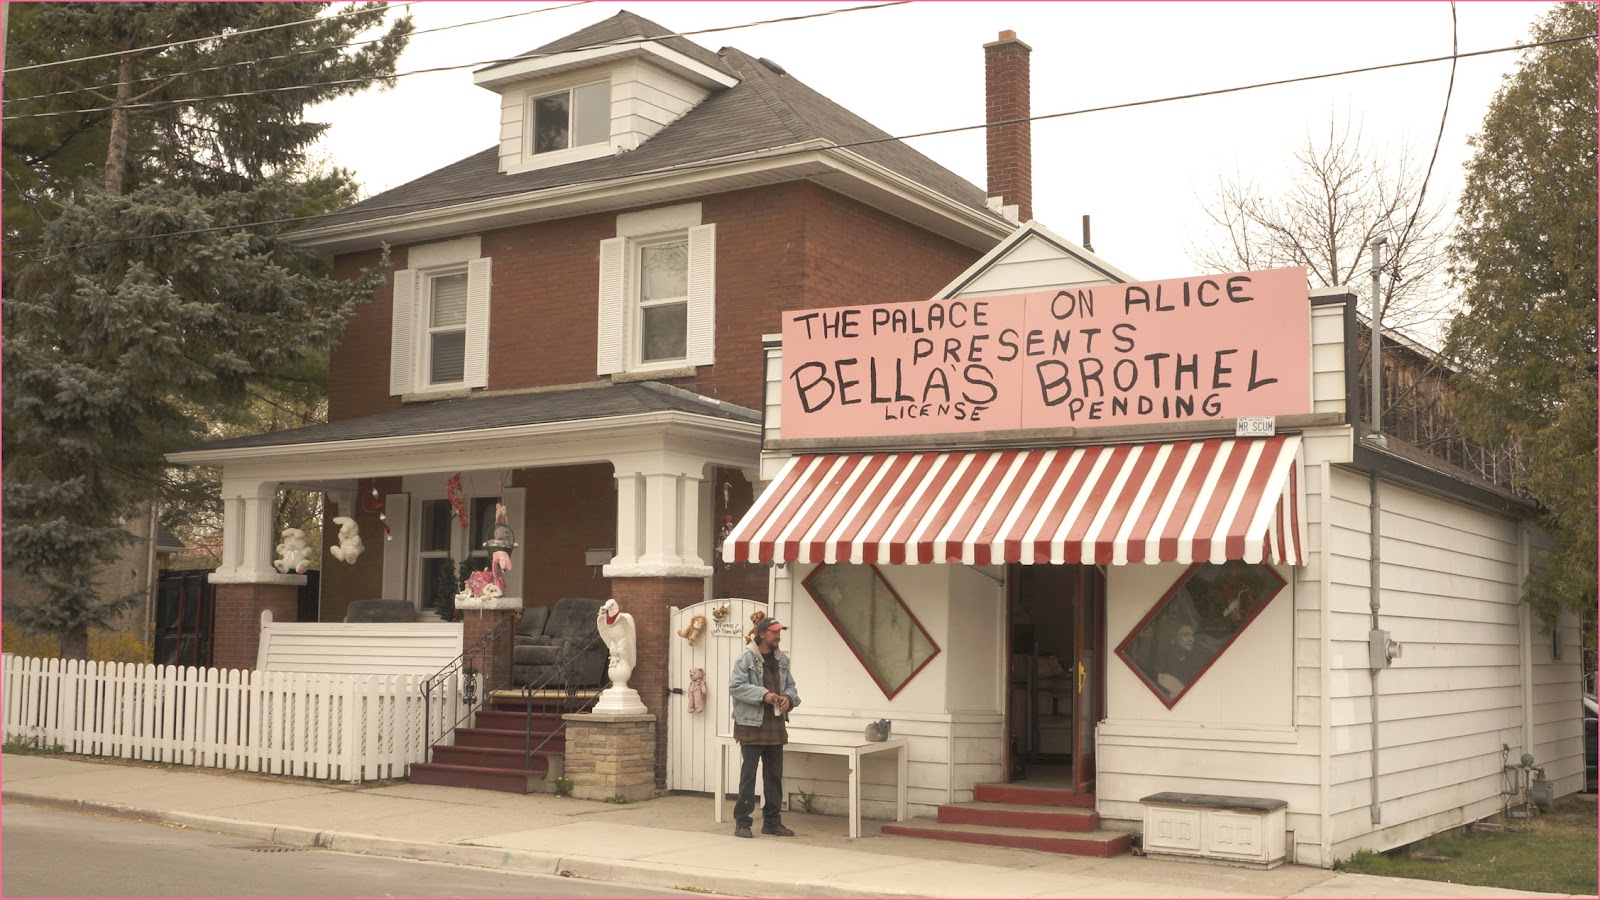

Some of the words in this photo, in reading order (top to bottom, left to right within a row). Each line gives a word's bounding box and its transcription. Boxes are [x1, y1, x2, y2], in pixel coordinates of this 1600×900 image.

[793, 310, 861, 339] THE
[873, 302, 989, 335] PALACE
[1051, 290, 1093, 319] ON
[1125, 276, 1254, 315] ALICE
[913, 323, 1136, 365] PRESENTS
[790, 357, 998, 413] BELLA'S
[1036, 349, 1278, 406] BROTHEL
[885, 402, 989, 421] LICENSE
[1069, 393, 1222, 421] PENDING
[1238, 421, 1249, 432] MR
[1252, 421, 1273, 432] SCUM
